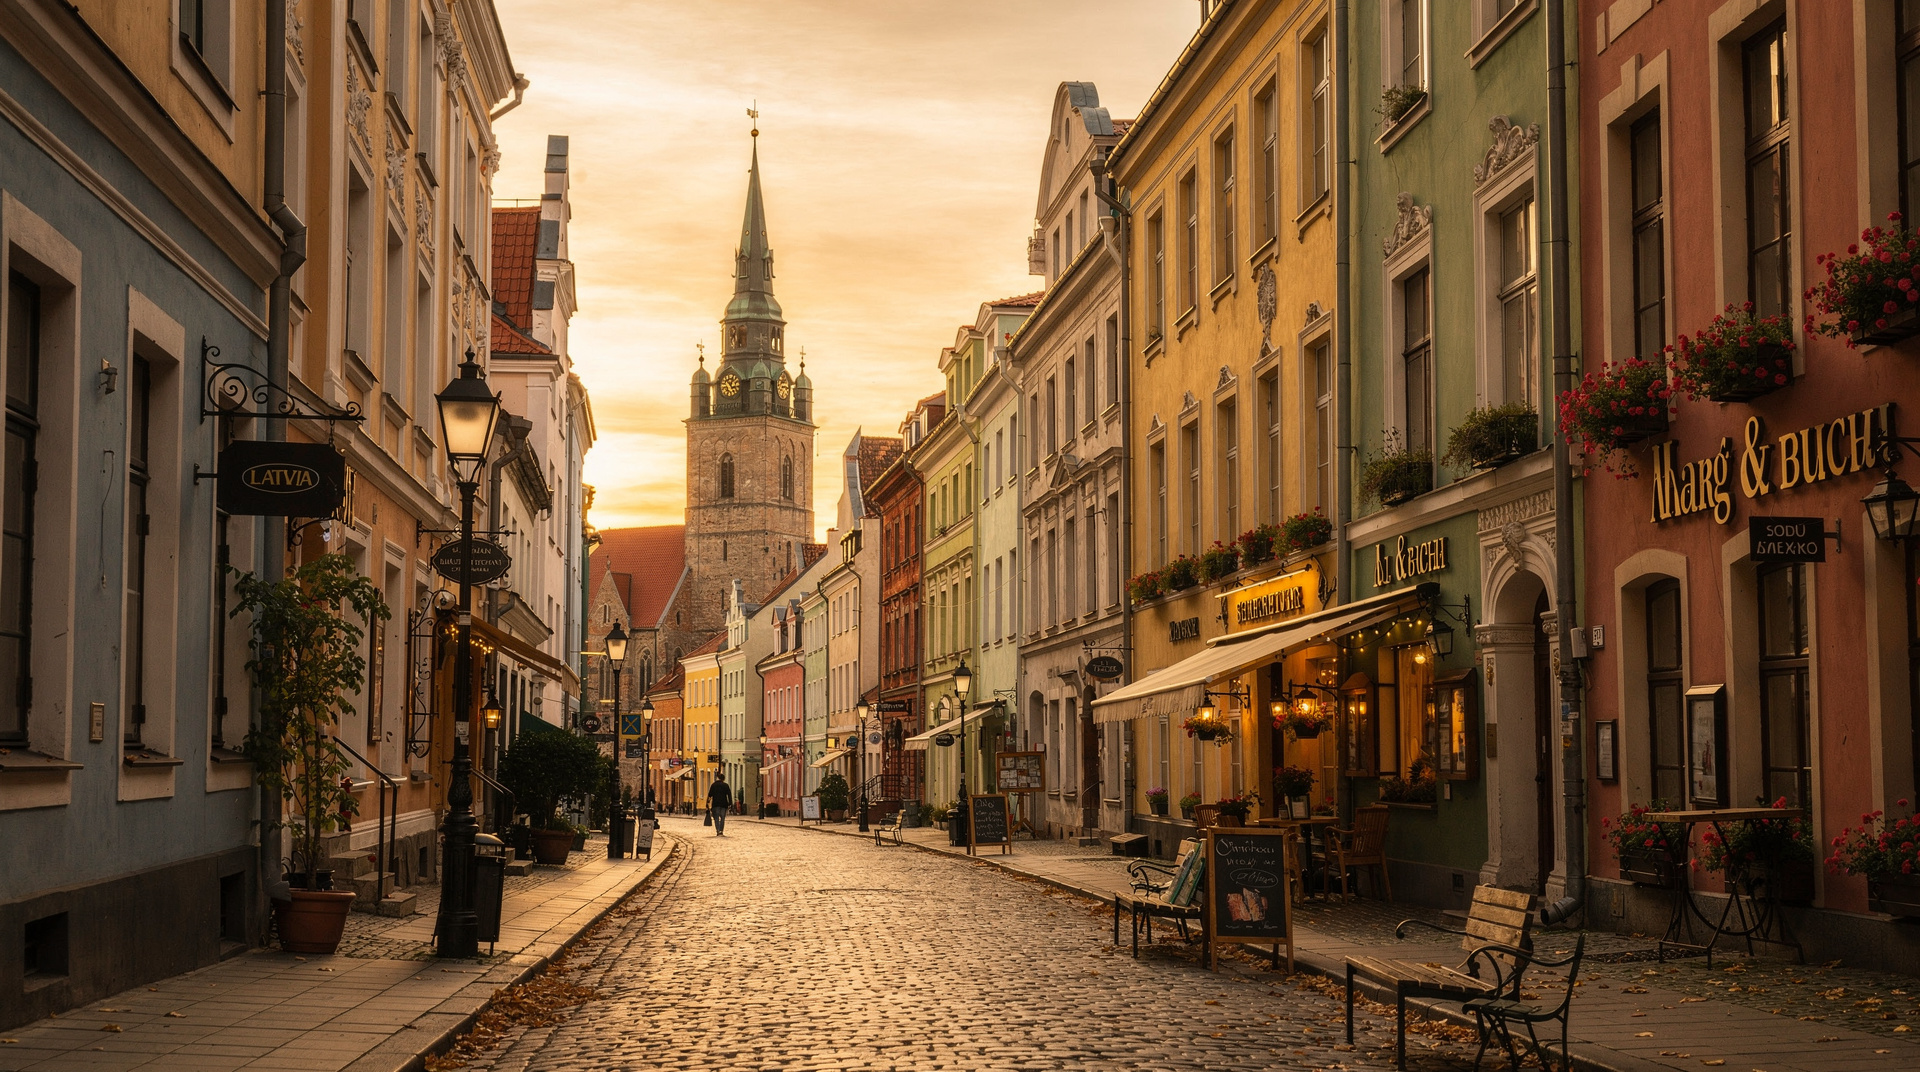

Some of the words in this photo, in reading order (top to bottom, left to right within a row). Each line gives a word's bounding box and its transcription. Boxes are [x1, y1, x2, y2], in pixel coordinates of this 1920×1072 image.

[1740, 416, 1771, 499] &
[250, 469, 313, 486] LATVIA
[1766, 524, 1807, 538] SODU
[1395, 534, 1407, 581] &
